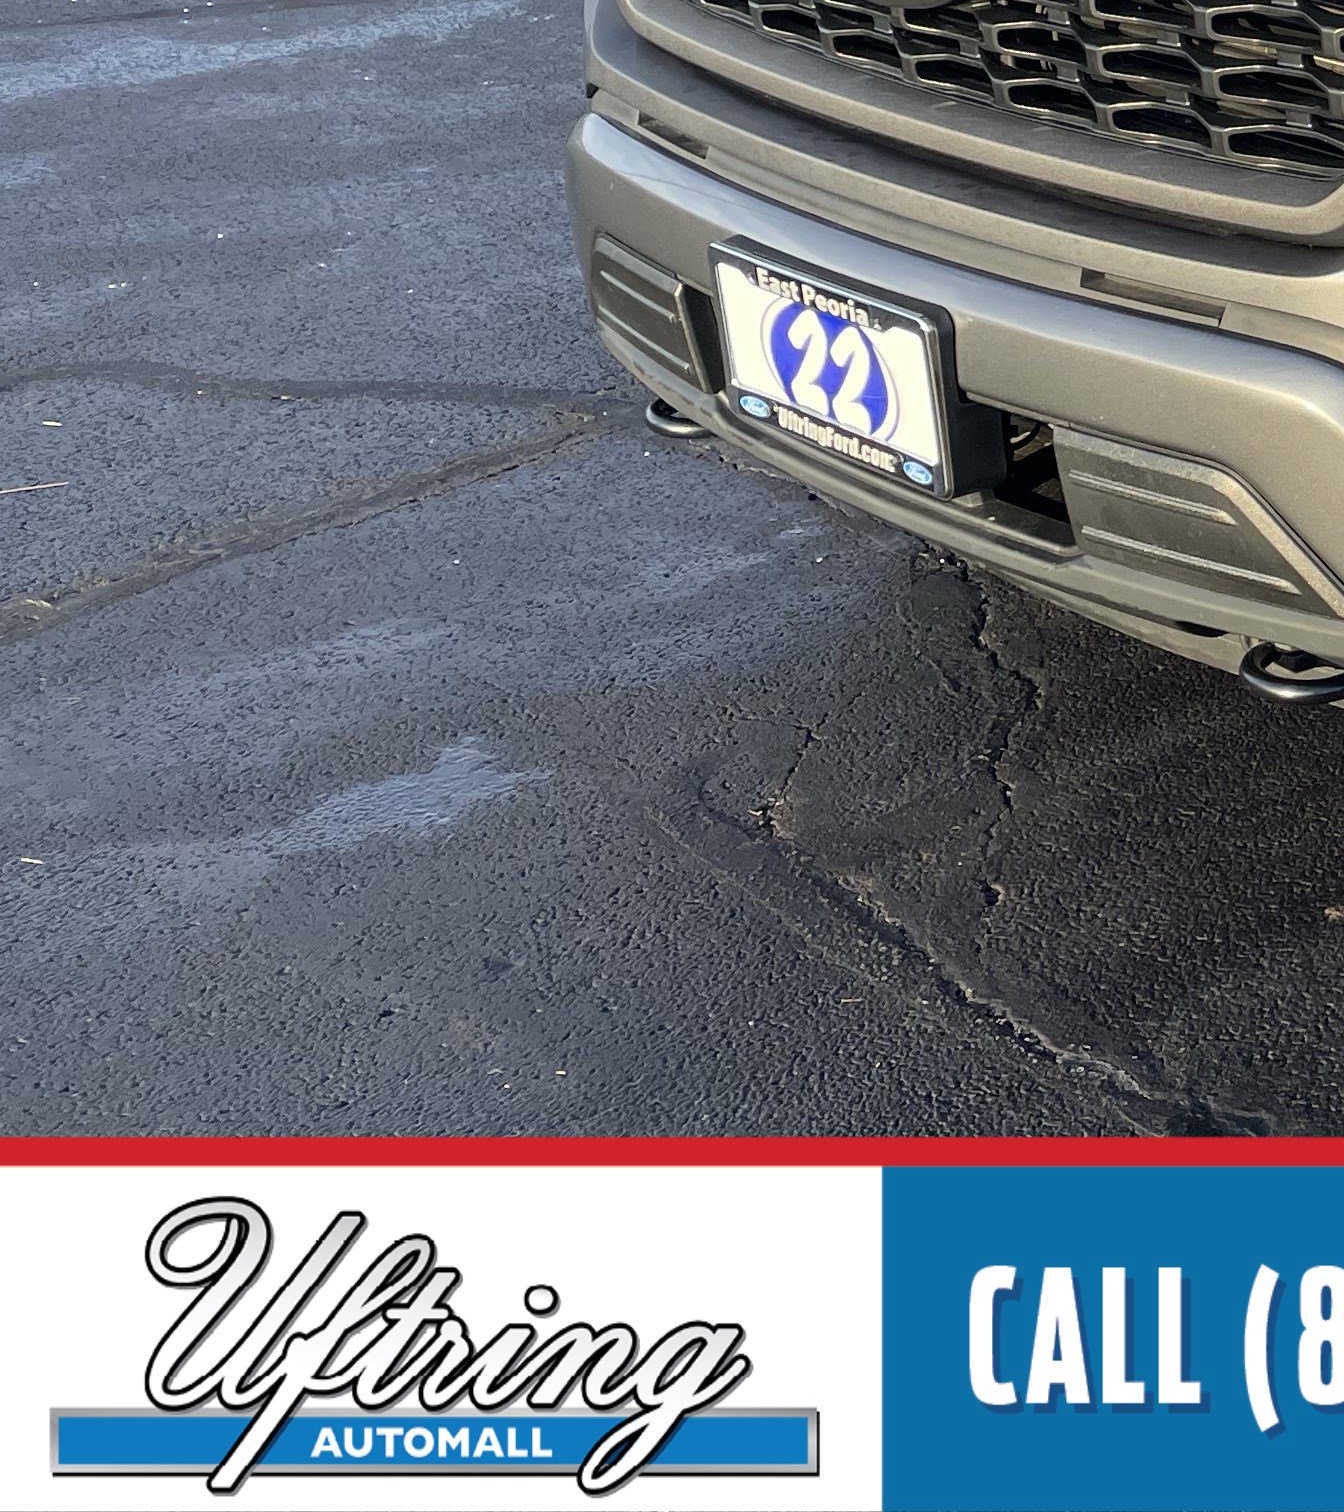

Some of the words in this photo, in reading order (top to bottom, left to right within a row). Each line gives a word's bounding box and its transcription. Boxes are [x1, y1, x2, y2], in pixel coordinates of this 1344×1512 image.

[756, 267, 800, 302] East
[801, 283, 870, 328] Peoria
[787, 308, 872, 437] 22
